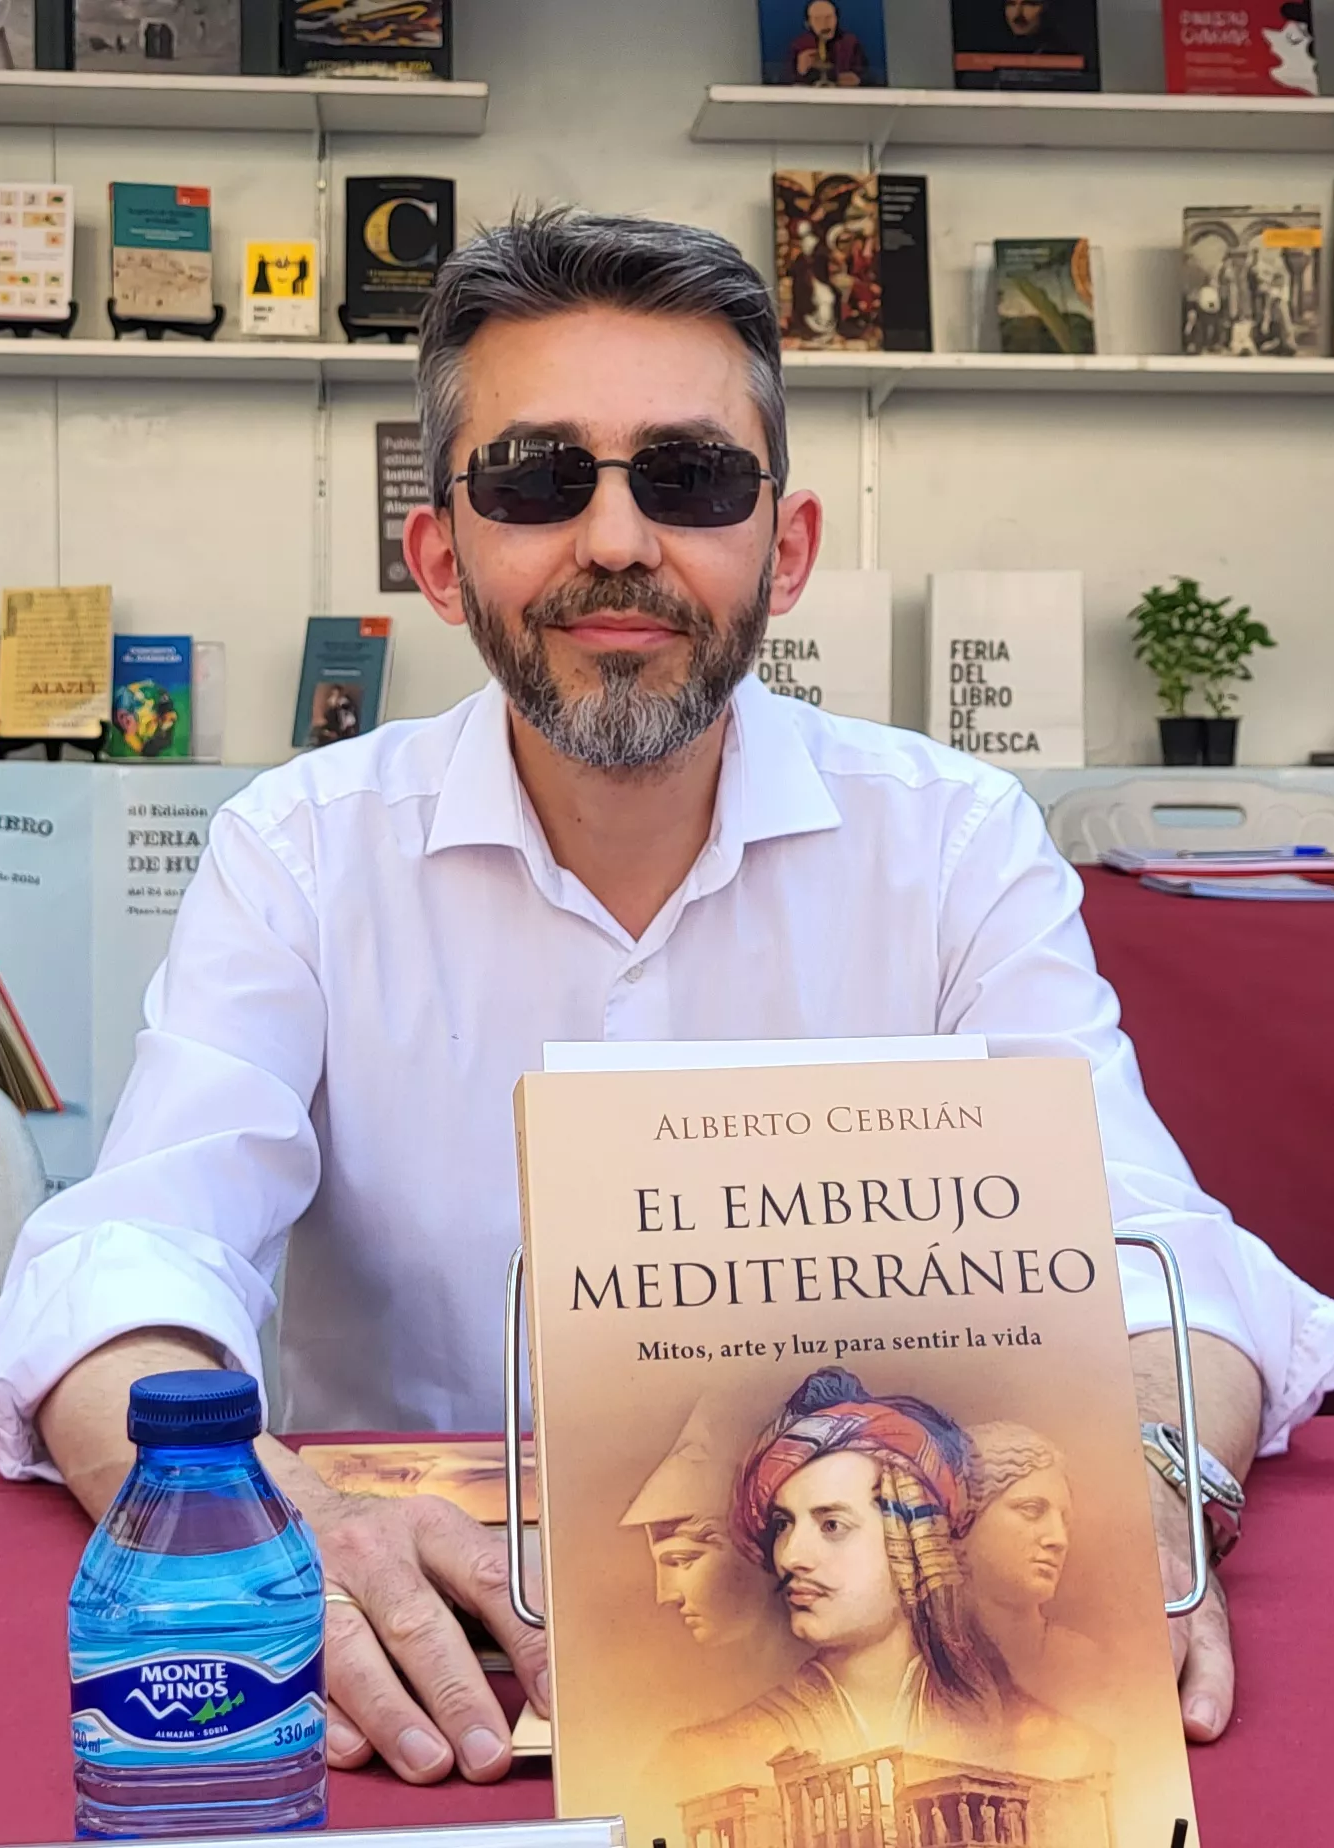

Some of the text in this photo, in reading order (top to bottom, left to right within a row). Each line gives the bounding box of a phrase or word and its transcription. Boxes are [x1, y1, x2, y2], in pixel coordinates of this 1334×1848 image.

[758, 639, 819, 661] FERIA
[950, 639, 1009, 661] FERIA
[758, 663, 797, 683] DEL
[950, 663, 987, 684] DEL
[950, 686, 1012, 708] LIBRO
[949, 710, 976, 730] DE
[950, 732, 1041, 754] HUESCA
[128, 830, 201, 846] FERIA
[128, 856, 160, 872] DE
[632, 1173, 1020, 1233] EL EMBRUJO
[569, 1241, 1096, 1311] MEDITERRÁNEO
[637, 1325, 1042, 1364] Mitos, arte y luz para sentir la vida
[140, 1662, 228, 1683] MONTE
[151, 1681, 229, 1701] PINOS
[155, 1724, 229, 1739] ALMAZÁN SORIA
[273, 1723, 317, 1747] 330 ml
[88, 1736, 101, 1753] ml
